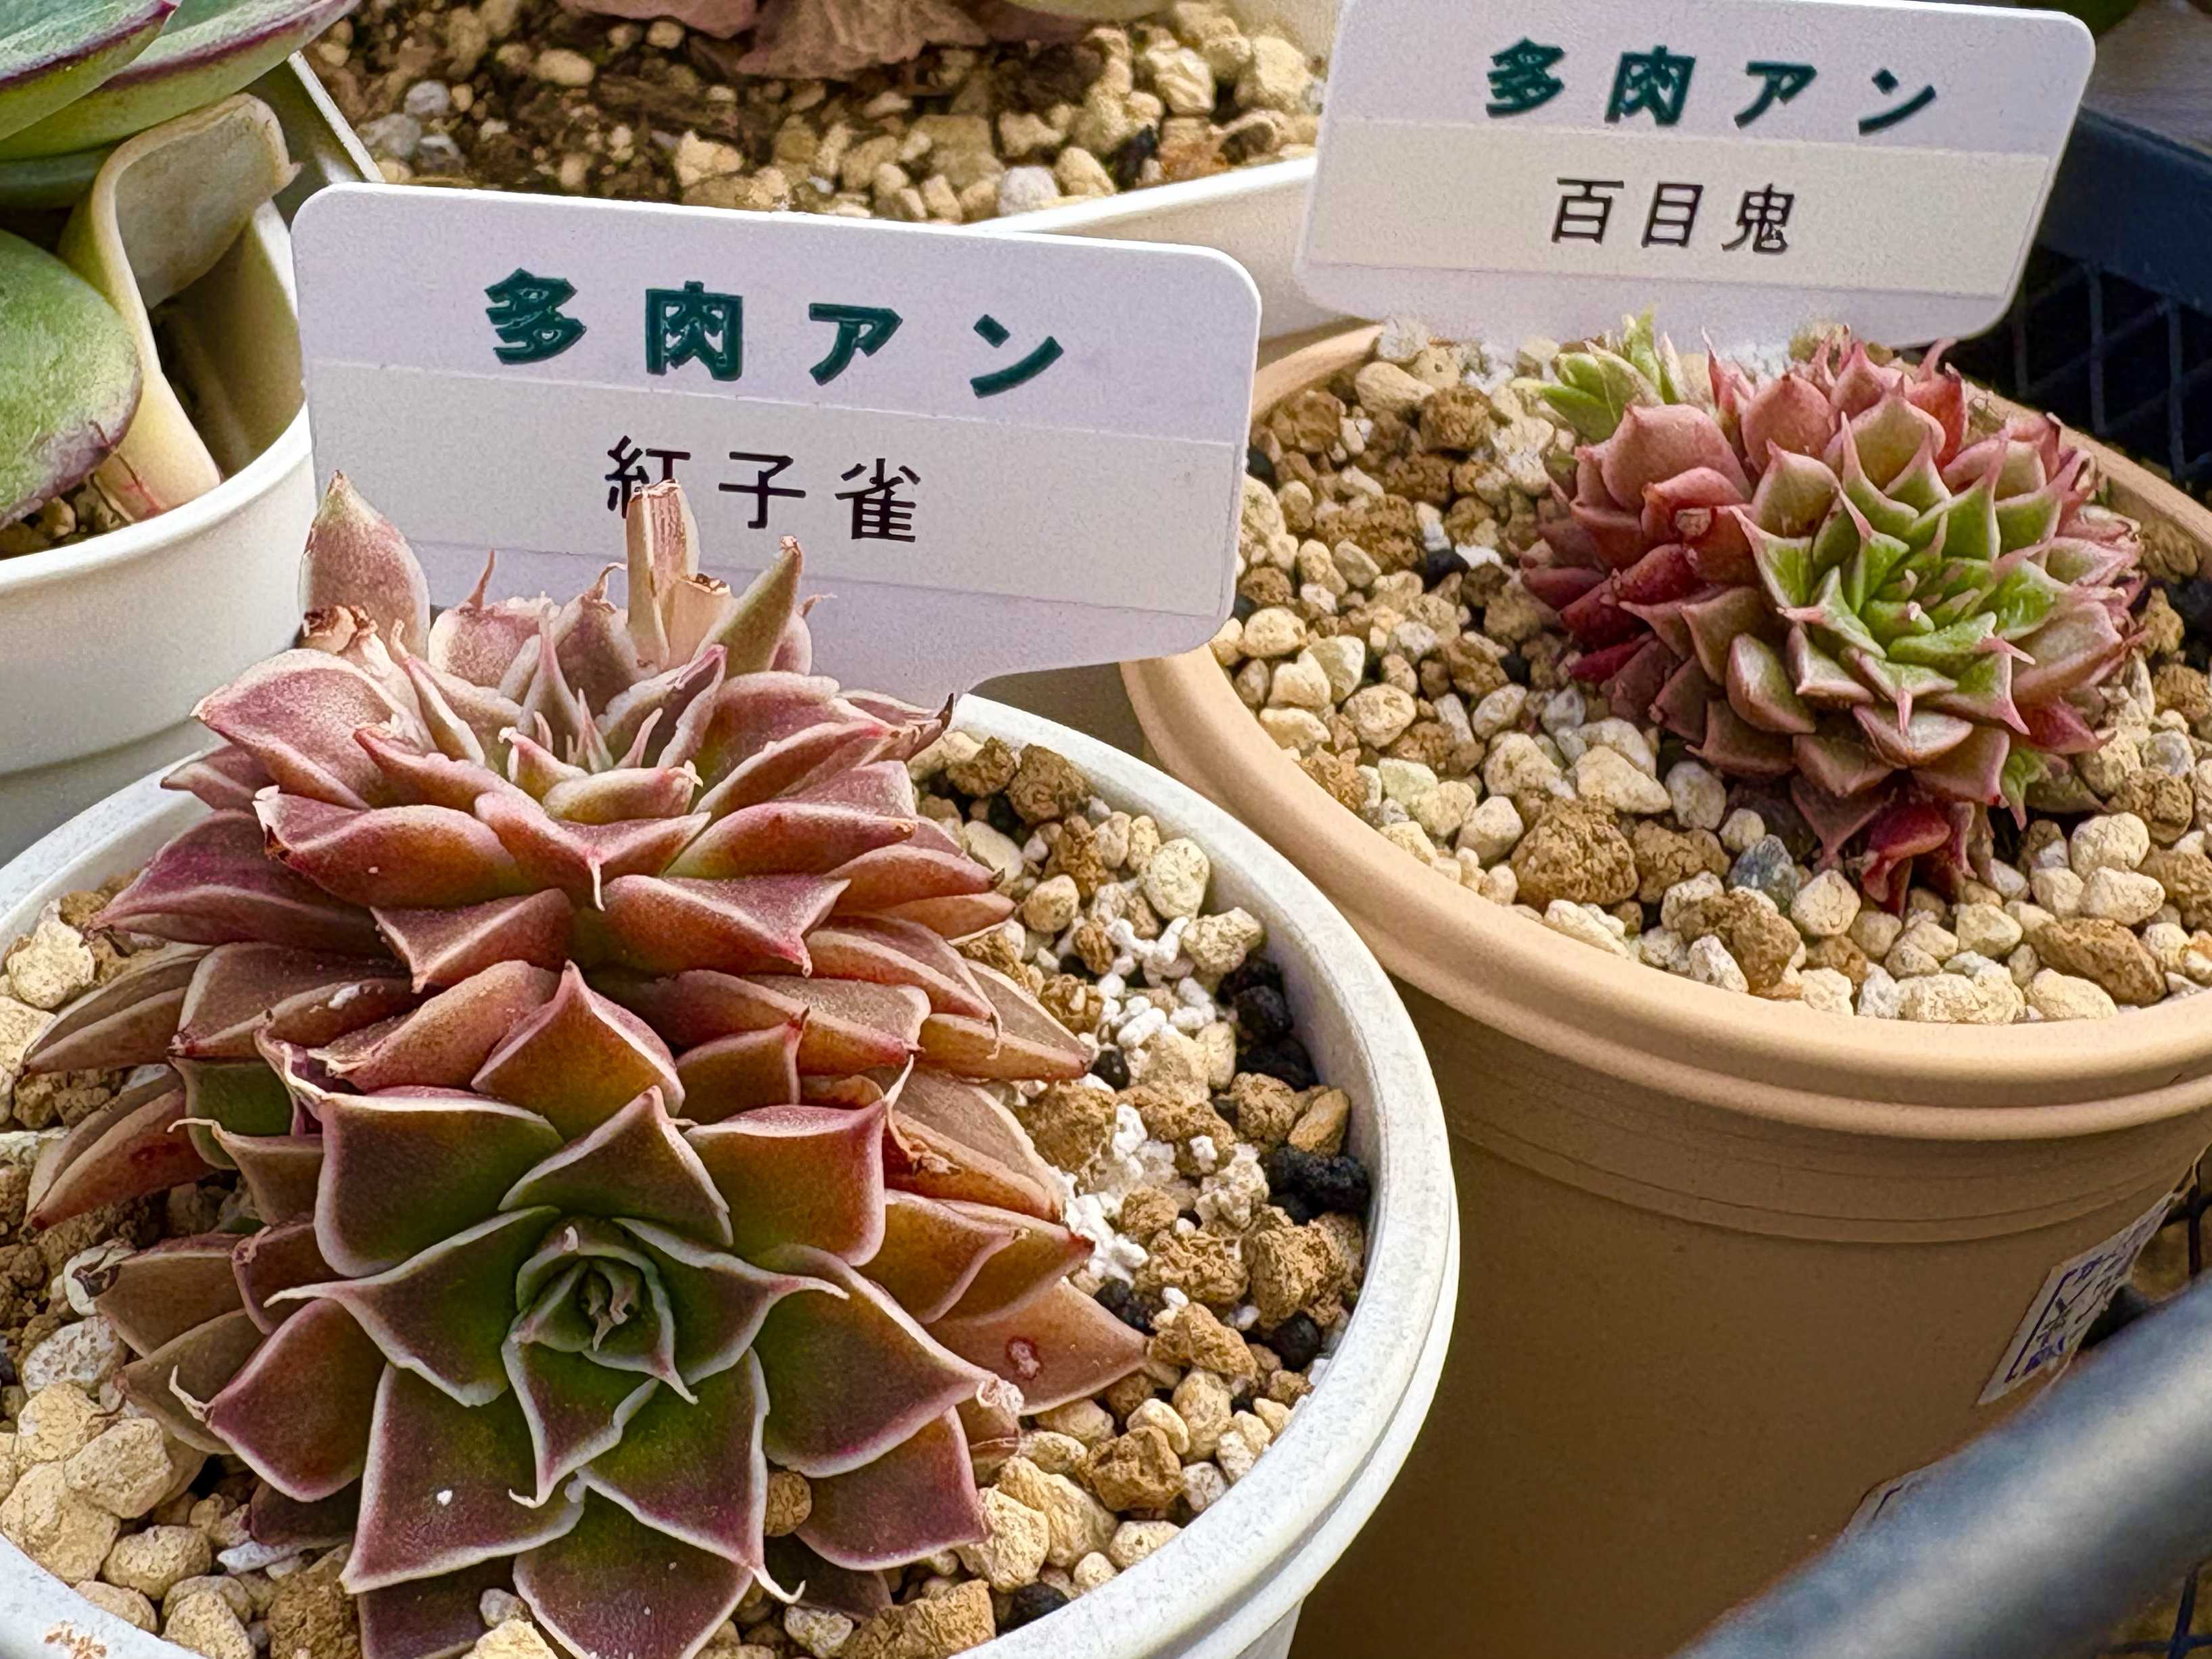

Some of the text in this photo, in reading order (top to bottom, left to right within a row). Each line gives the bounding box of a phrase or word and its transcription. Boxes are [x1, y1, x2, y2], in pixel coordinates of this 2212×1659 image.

[1485, 37, 1938, 135] 多肉アン
[1551, 177, 1796, 255] 百目鬼
[483, 267, 1065, 400] 多肉アン
[604, 435, 921, 544] 紅子雀
